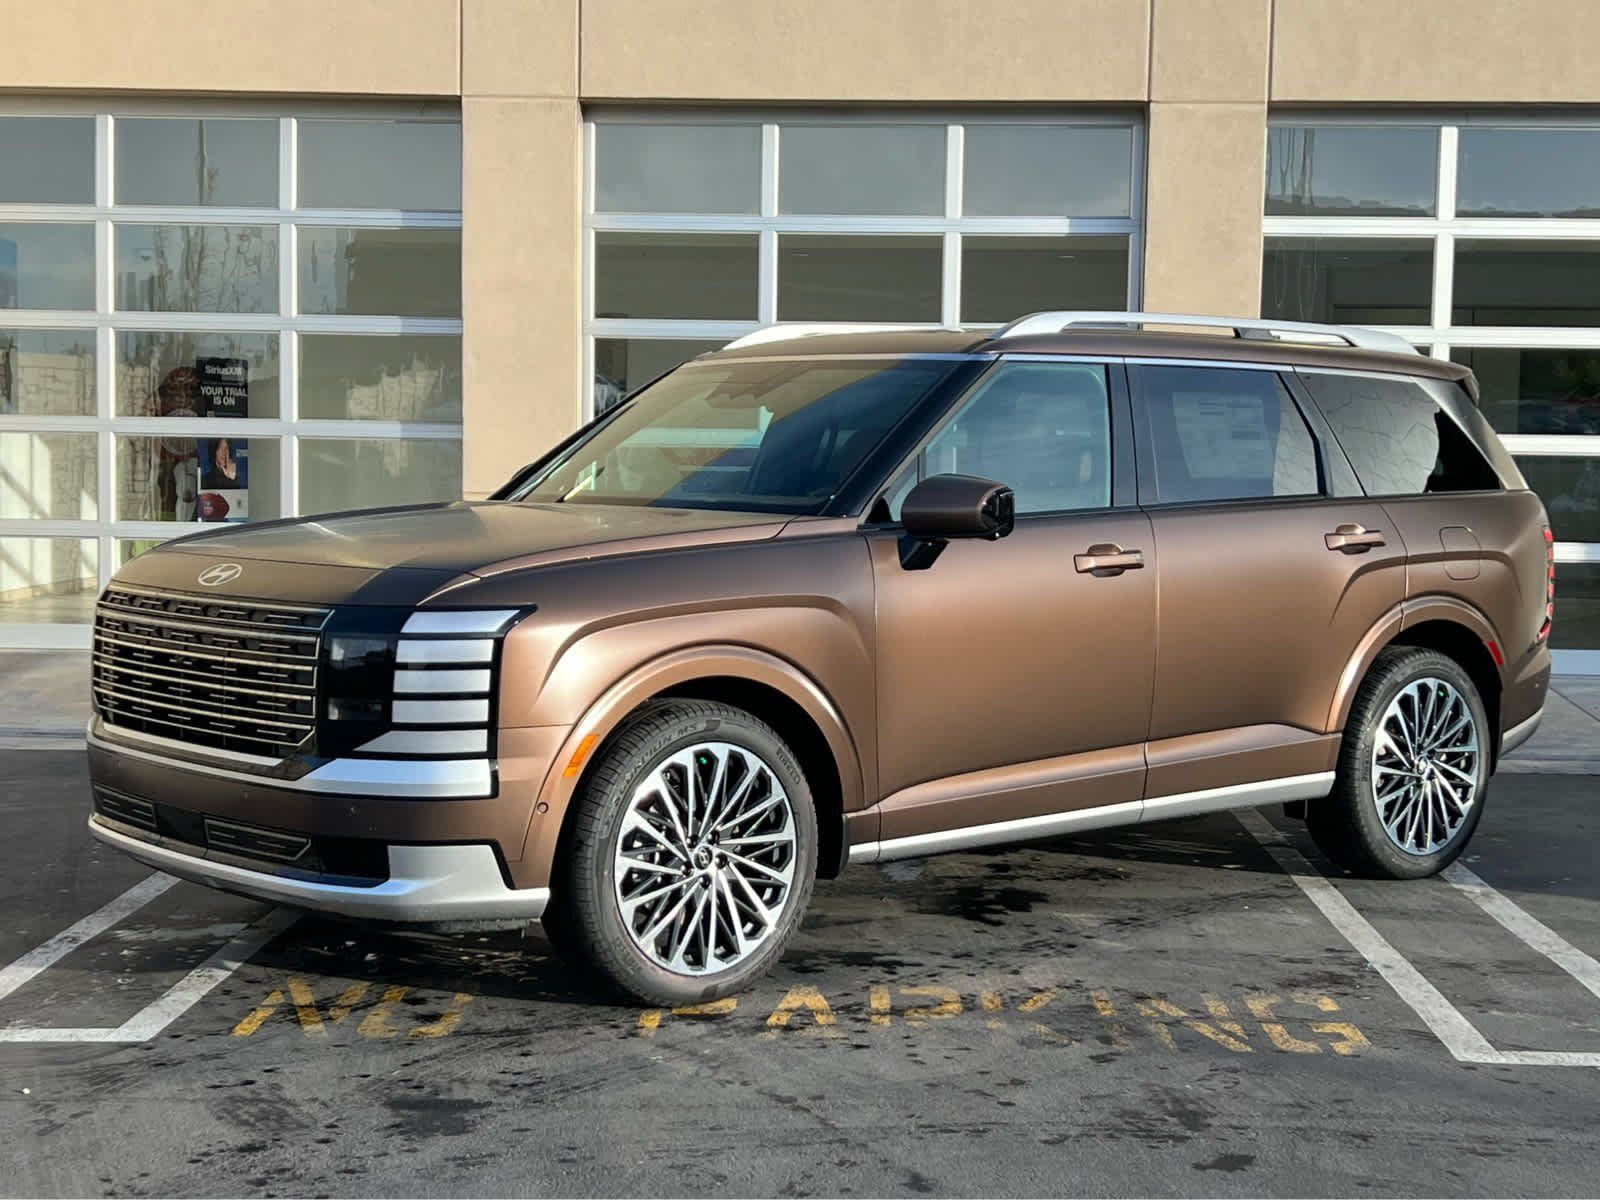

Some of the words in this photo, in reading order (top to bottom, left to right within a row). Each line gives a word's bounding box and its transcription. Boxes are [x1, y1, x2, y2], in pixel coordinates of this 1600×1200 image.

[200, 385, 224, 396] YOUR
[224, 386, 248, 397] TRIAL
[213, 396, 222, 405] IS
[222, 396, 236, 406] ON
[230, 977, 475, 1039] NO
